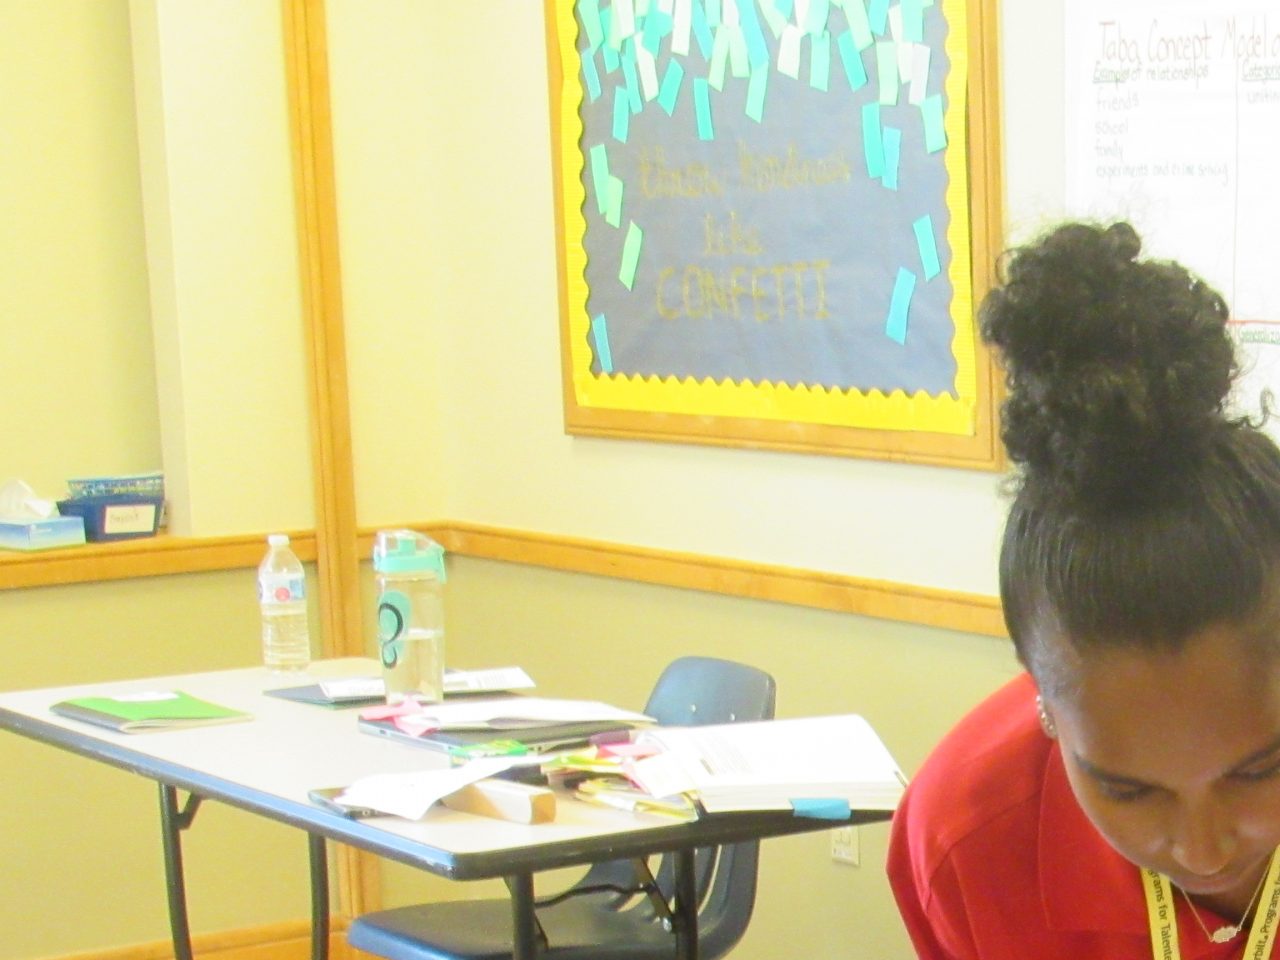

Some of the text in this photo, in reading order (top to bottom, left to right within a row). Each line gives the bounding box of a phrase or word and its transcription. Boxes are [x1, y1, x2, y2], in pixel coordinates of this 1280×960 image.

[1147, 18, 1213, 66] Concept
[1221, 13, 1267, 59] Model
[1146, 64, 1210, 89] relationships
[655, 258, 832, 323] CONFETTI
[1158, 903, 1169, 922] for
